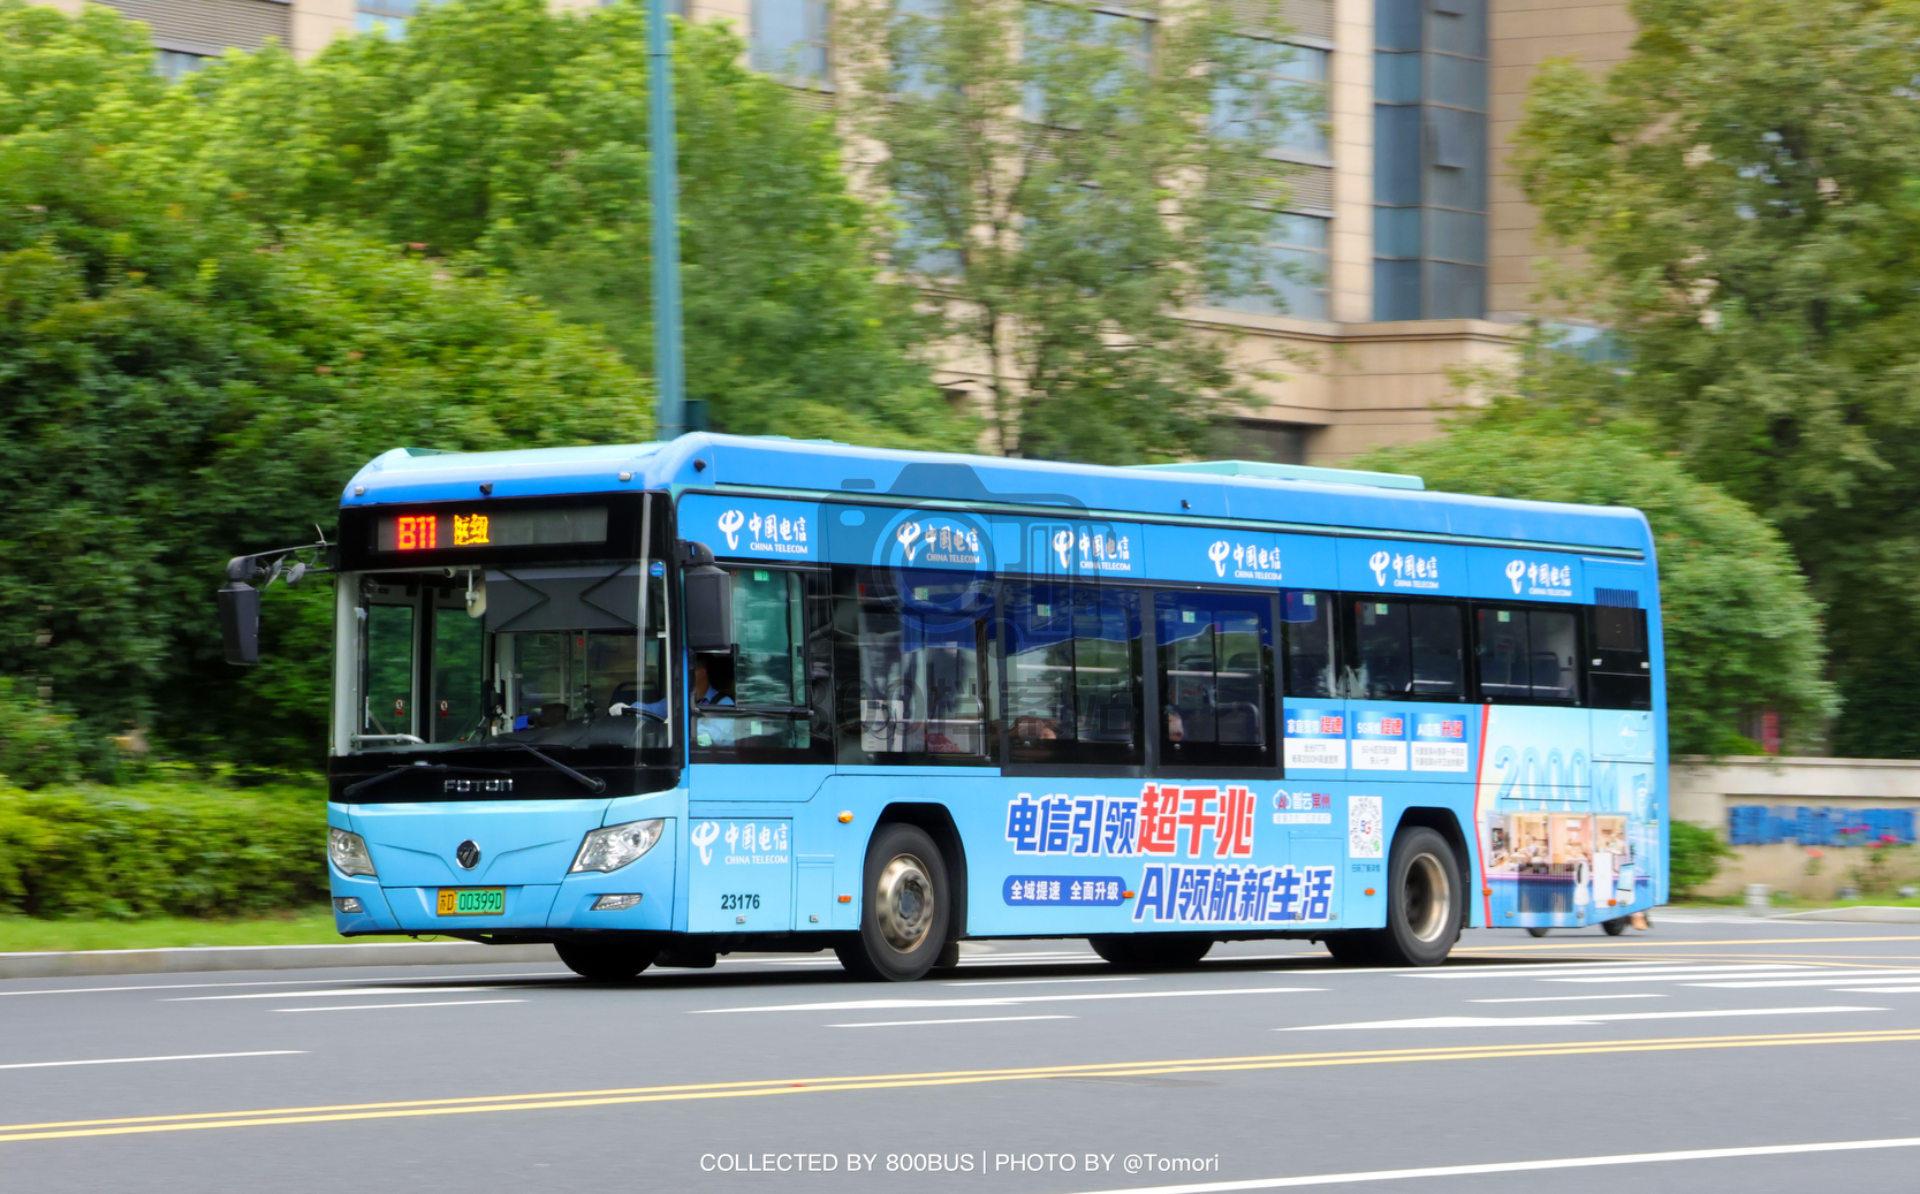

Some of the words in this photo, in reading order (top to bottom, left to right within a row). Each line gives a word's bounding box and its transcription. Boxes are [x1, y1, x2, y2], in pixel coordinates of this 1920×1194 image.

[398, 515, 437, 549] B11
[748, 511, 807, 542] 中国电信
[925, 523, 979, 553] 中国电信
[750, 542, 773, 552] CHINA
[775, 544, 808, 554] TELECOM
[926, 553, 949, 563] CHINA
[949, 554, 980, 564] TELECOM
[1078, 533, 1130, 560] 中国电信
[1233, 543, 1281, 570] 中国电信
[1080, 561, 1100, 569] CHINA
[1101, 561, 1131, 571] TELECOM
[1234, 570, 1254, 578] CHINA
[1255, 571, 1282, 580] TELECOM
[1392, 553, 1438, 579] 中国电信
[1527, 562, 1571, 587] 中国电信
[443, 779, 514, 793] FOTON
[1006, 783, 1256, 858] 电信引领超千兆
[724, 822, 788, 854] 中国电信
[725, 855, 750, 865] CHINA
[752, 855, 788, 864] TELECOM
[721, 894, 760, 910] 23176
[1011, 880, 1061, 901] 全域提速
[1070, 880, 1120, 901] 全面升级
[1132, 863, 1335, 923] AI领航新生活
